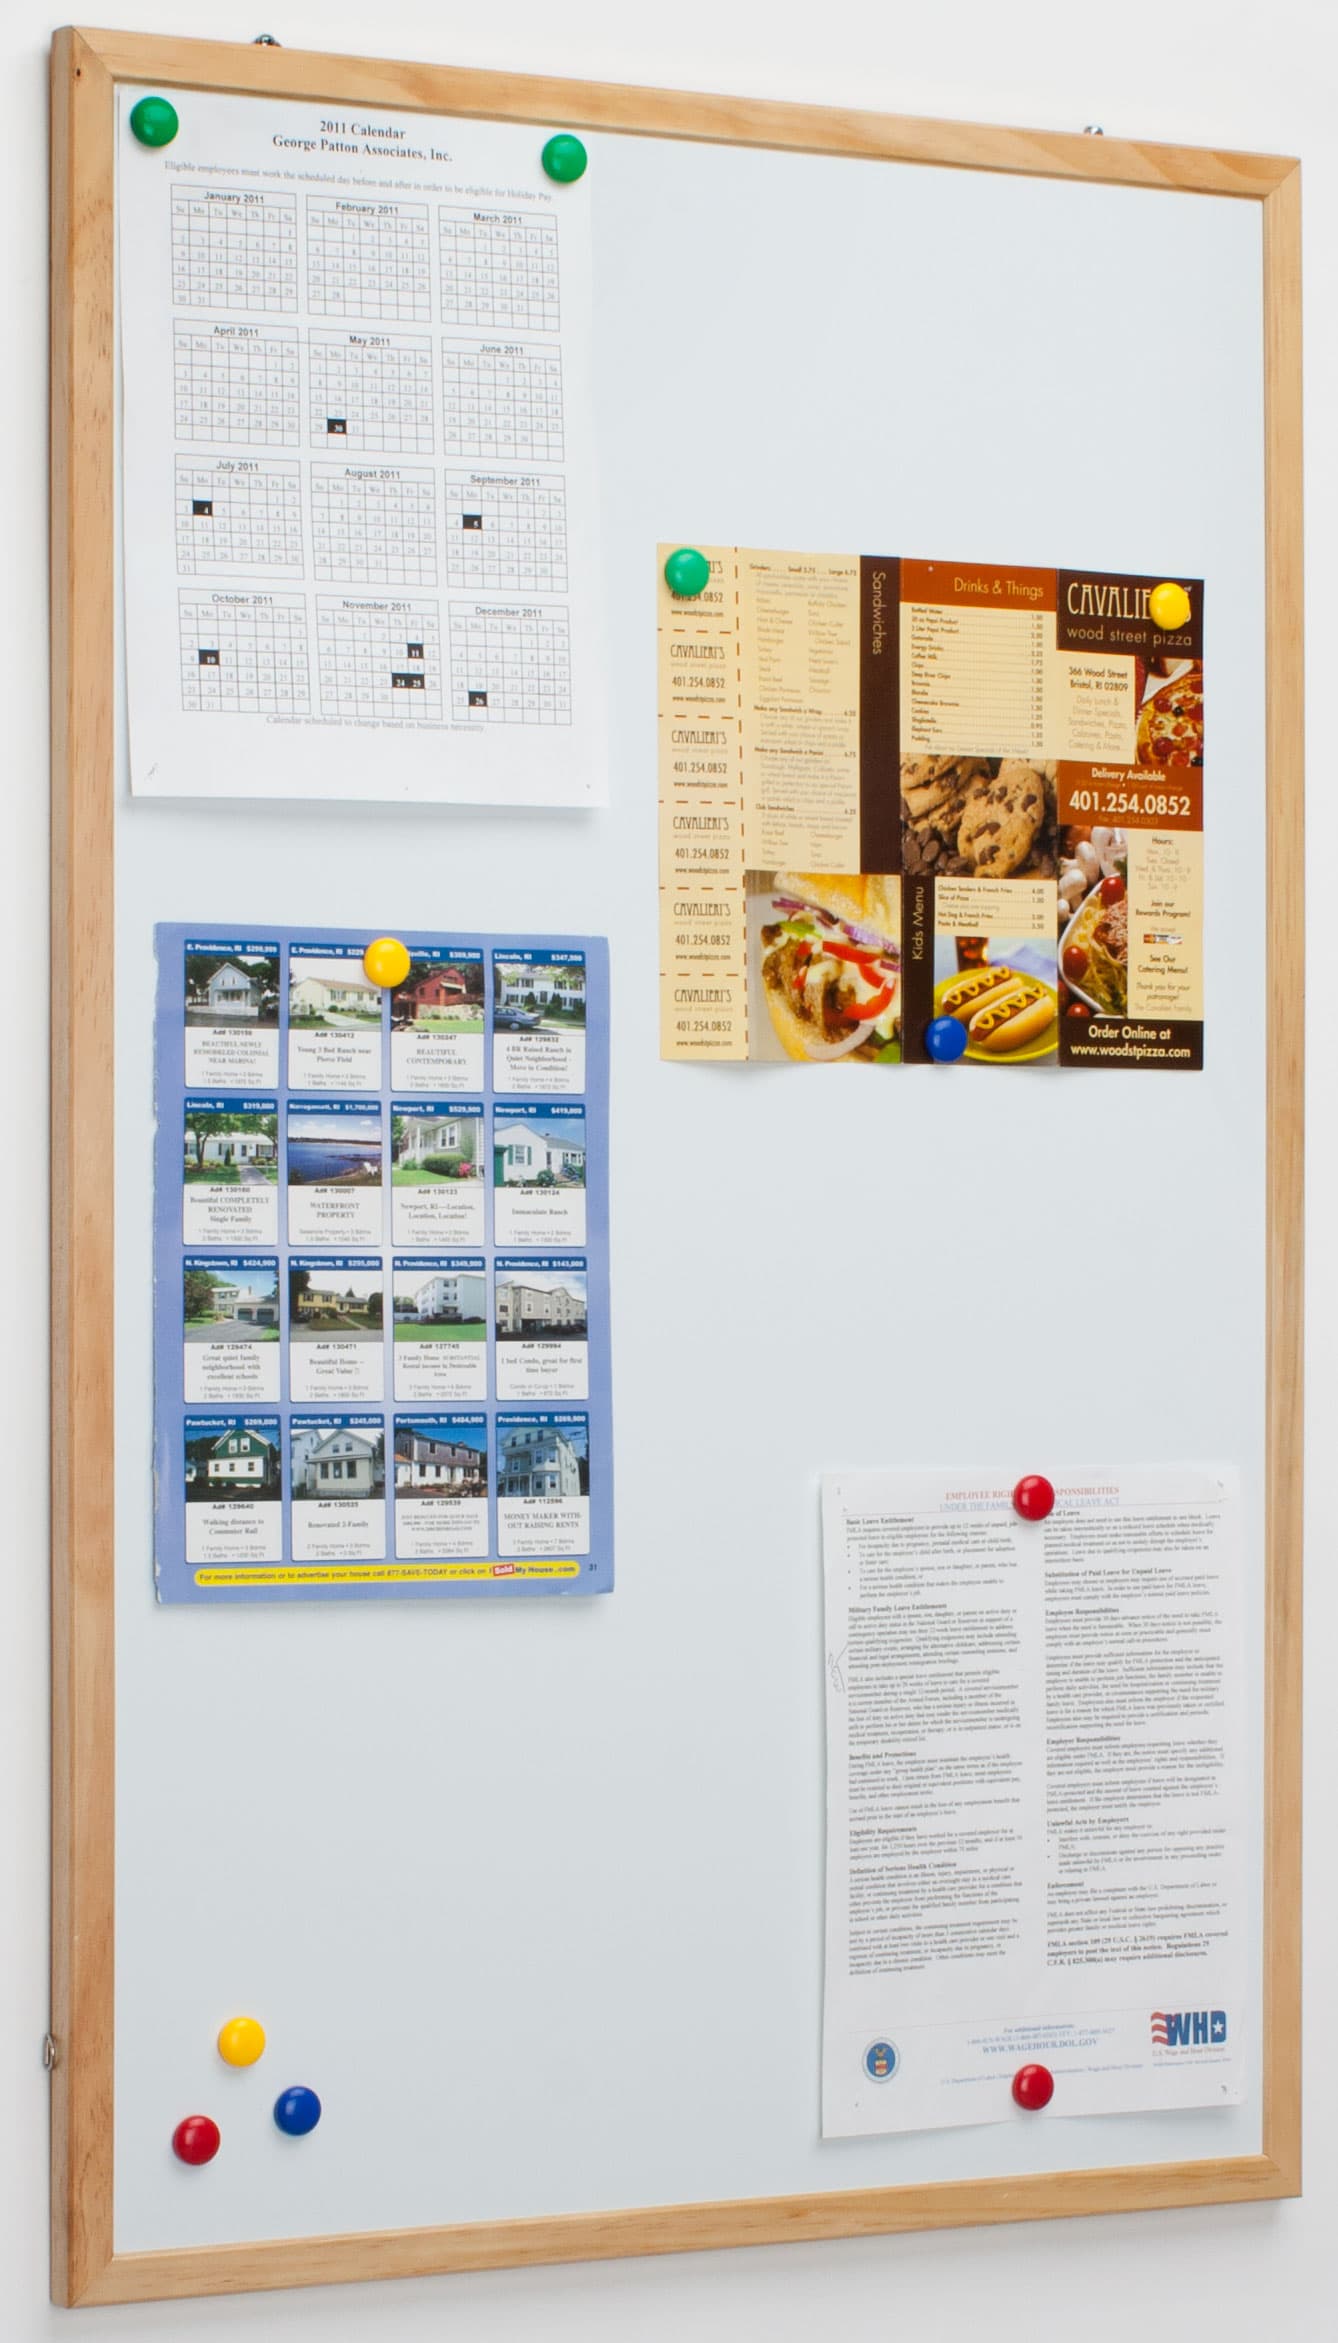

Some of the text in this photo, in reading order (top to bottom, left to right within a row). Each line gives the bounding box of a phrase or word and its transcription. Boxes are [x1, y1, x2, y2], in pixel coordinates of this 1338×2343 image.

[320, 120, 405, 139] 2011 Calendar
[272, 134, 452, 161] George Patton Associates, Inc.
[204, 191, 264, 204] January 2011
[335, 201, 399, 216] February 2011
[473, 213, 522, 225] March 2011
[213, 325, 259, 338] April 2011
[349, 336, 390, 348] May 2011
[480, 344, 523, 356] June 2011
[216, 460, 259, 472] July 2011
[345, 468, 400, 480] August 2011
[470, 474, 540, 488] September 2011
[954, 577, 1043, 600] Drinks & Things
[211, 593, 273, 605] October 2011
[342, 600, 412, 612] November 2011
[475, 606, 543, 618] December 2011
[872, 572, 886, 655] Sandwiches
[1067, 626, 1192, 647] wood street pizza
[1069, 666, 1128, 679] 366 Wood Street
[672, 676, 725, 688] 401.254.0852
[1070, 679, 1128, 691] Bristol, RI 02809
[673, 761, 727, 774] 401.254.0852
[1091, 767, 1166, 782] Delivery Available
[1069, 790, 1190, 815] 401.254.0852
[675, 847, 729, 859] 401.254.0852
[912, 886, 925, 960] Kids Menu
[675, 934, 730, 945] 401.254.0852
[676, 1020, 731, 1032] 401.254.0852
[1088, 1025, 1171, 1040] Order Online at
[1070, 1043, 1190, 1060] www.woodstpizza.com
[200, 1573, 212, 1581] For
[235, 1572, 276, 1580] information
[288, 1571, 295, 1579] to
[297, 1570, 330, 1578] advertise
[332, 1571, 348, 1579] your
[350, 1569, 370, 1577] house
[372, 1569, 385, 1577] call
[459, 1567, 475, 1575] click
[515, 1566, 526, 1576] My
[528, 1566, 553, 1574] House
[1165, 2010, 1226, 2046] WHD
